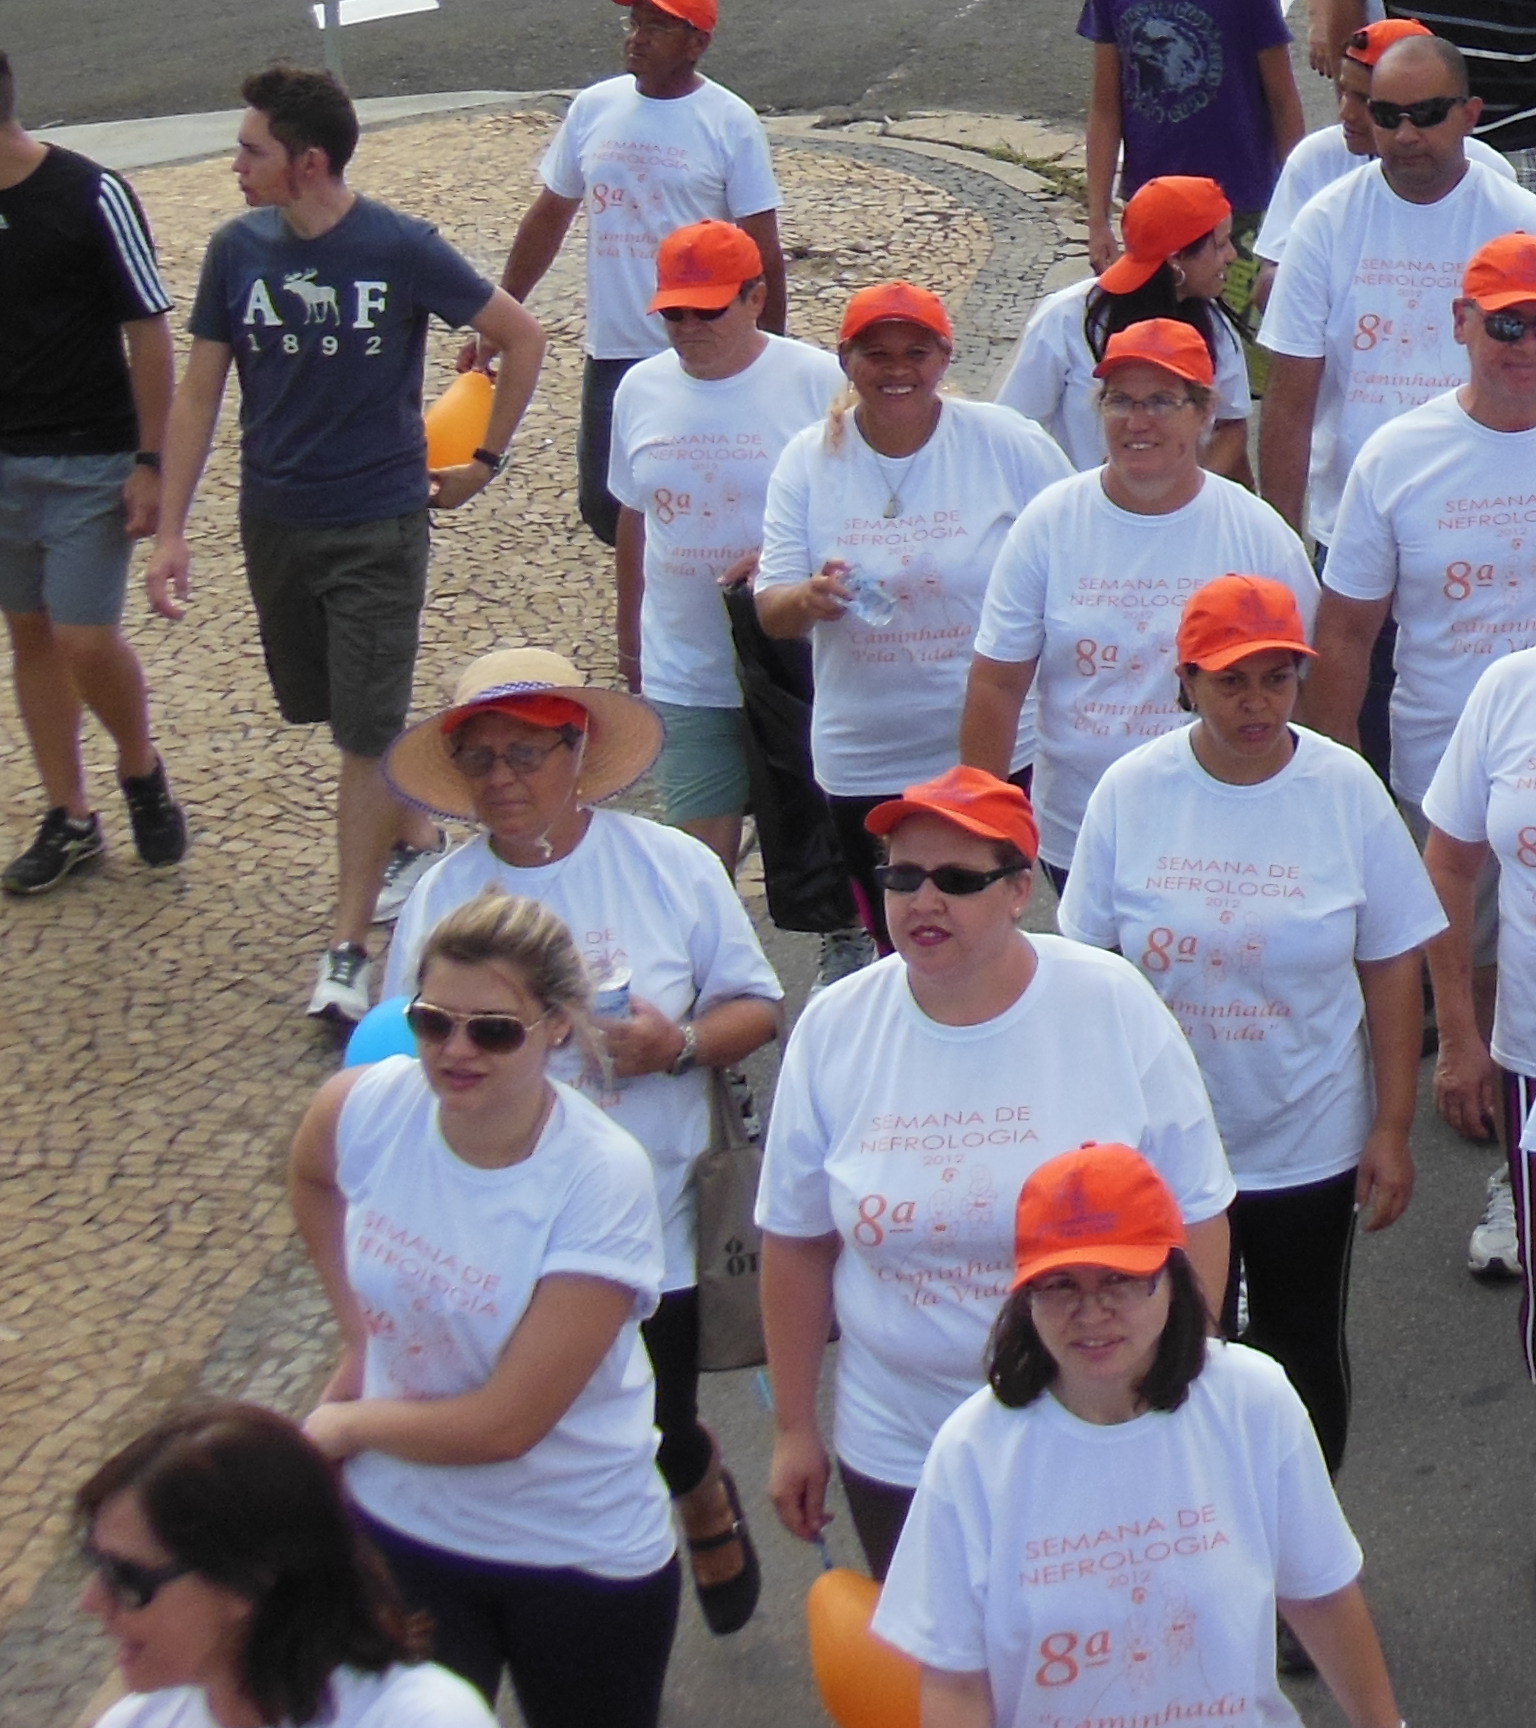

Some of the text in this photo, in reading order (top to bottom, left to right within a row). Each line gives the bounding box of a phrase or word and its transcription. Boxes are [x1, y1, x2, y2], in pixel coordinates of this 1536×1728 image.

[243, 279, 388, 329] A F
[1353, 313, 1395, 351] 8ª
[652, 432, 763, 446] SEMANA DE
[648, 447, 770, 462] NEFROLOGIA
[654, 487, 693, 524] 8ª
[843, 509, 961, 531] SEMANA DE
[836, 523, 969, 547] NEFROLOGIA
[1077, 576, 1170, 591] SEMANA
[1443, 561, 1495, 602] 8ª
[1074, 637, 1119, 676] 8ª
[1157, 855, 1300, 881] SEMANA DE
[1145, 876, 1307, 899] NEFROLOGIA
[1204, 894, 1241, 909] 2012
[1140, 926, 1198, 973] 8ª
[871, 1104, 1033, 1134] SEMANA DE
[860, 1126, 1039, 1155] NEFROLOGIA
[922, 1152, 965, 1168] 2012
[853, 1193, 917, 1247] 8ª
[1025, 1503, 1217, 1562] SEMANA DE
[1018, 1529, 1231, 1588] NEFROLOGIA
[1106, 1569, 1152, 1590] 2012
[1034, 1629, 1113, 1688] 8ª
